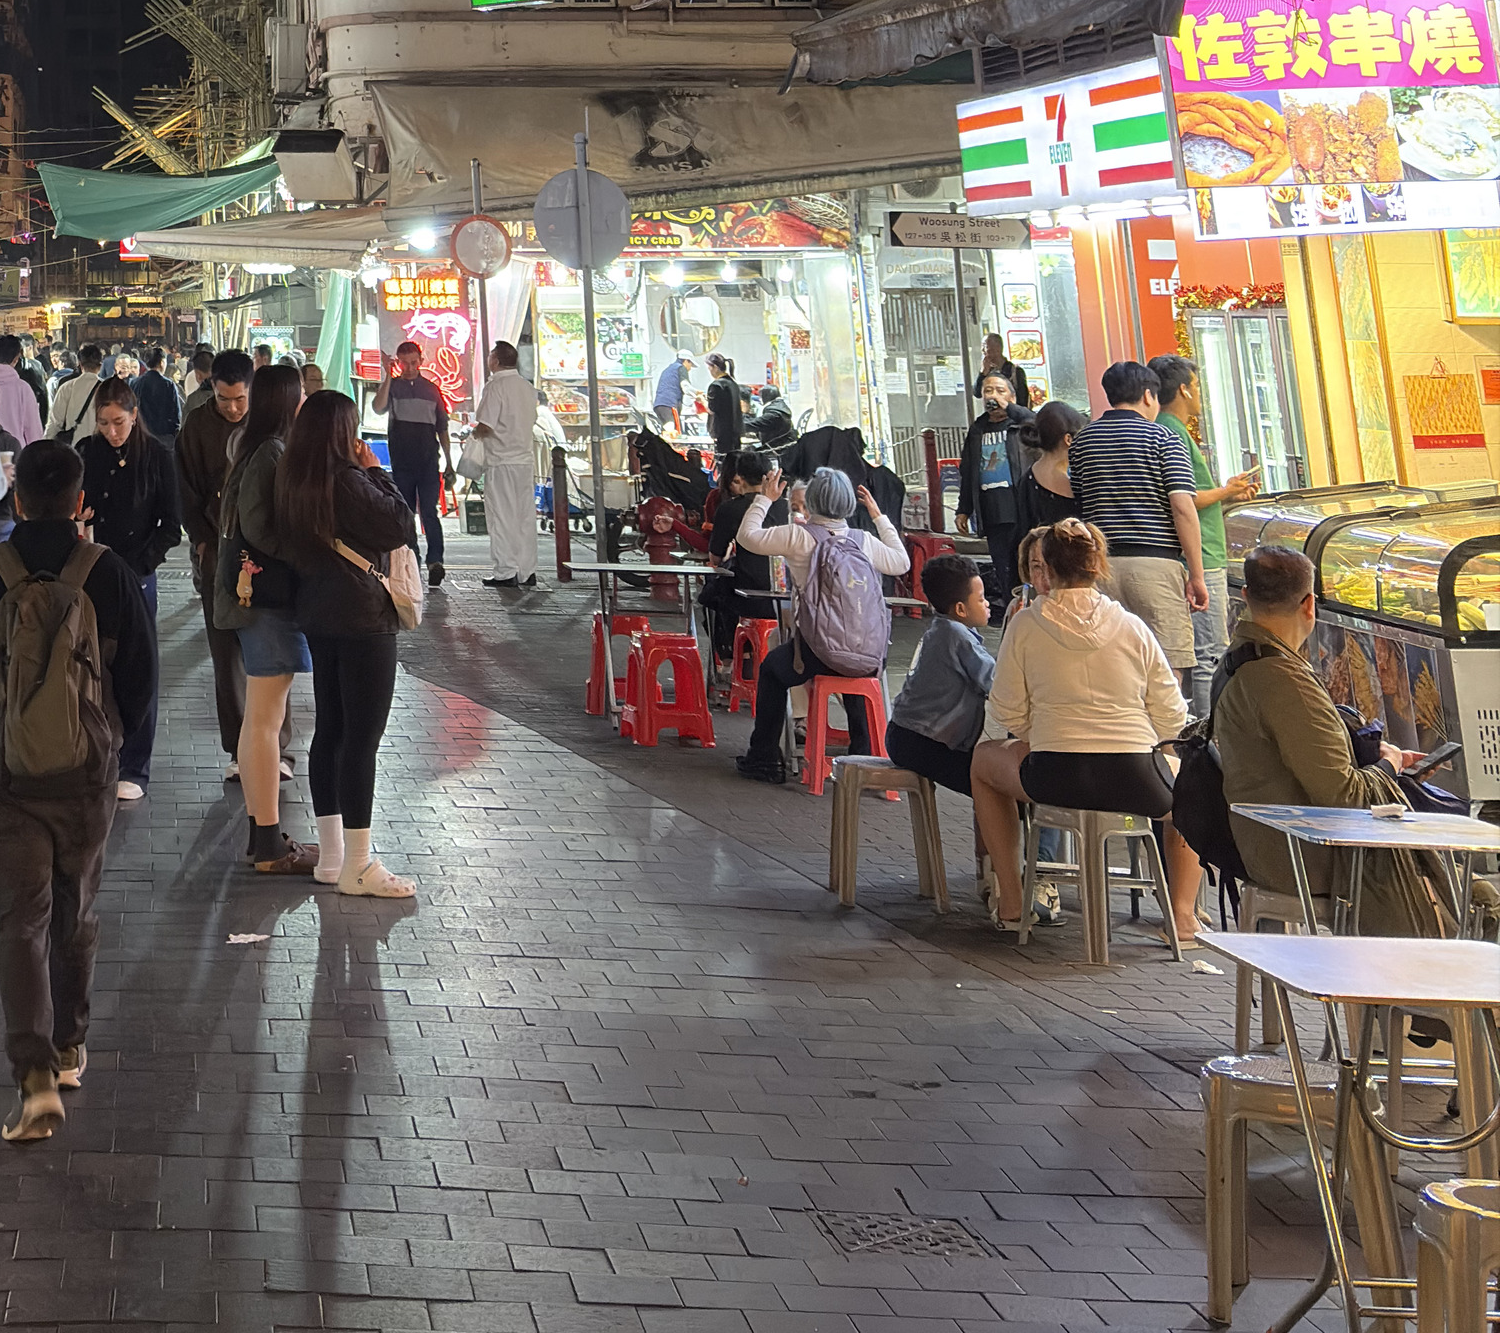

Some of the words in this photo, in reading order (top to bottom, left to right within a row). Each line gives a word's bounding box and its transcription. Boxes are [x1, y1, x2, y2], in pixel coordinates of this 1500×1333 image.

[1171, 1, 1485, 82] 佐敦串燒
[918, 216, 966, 229] Woosung
[968, 217, 1001, 228] Street
[628, 235, 648, 246] ICY
[650, 235, 681, 246] CRAB
[939, 231, 982, 244] 吳松街
[886, 263, 923, 275] DAVID
[923, 263, 977, 275] MANSON
